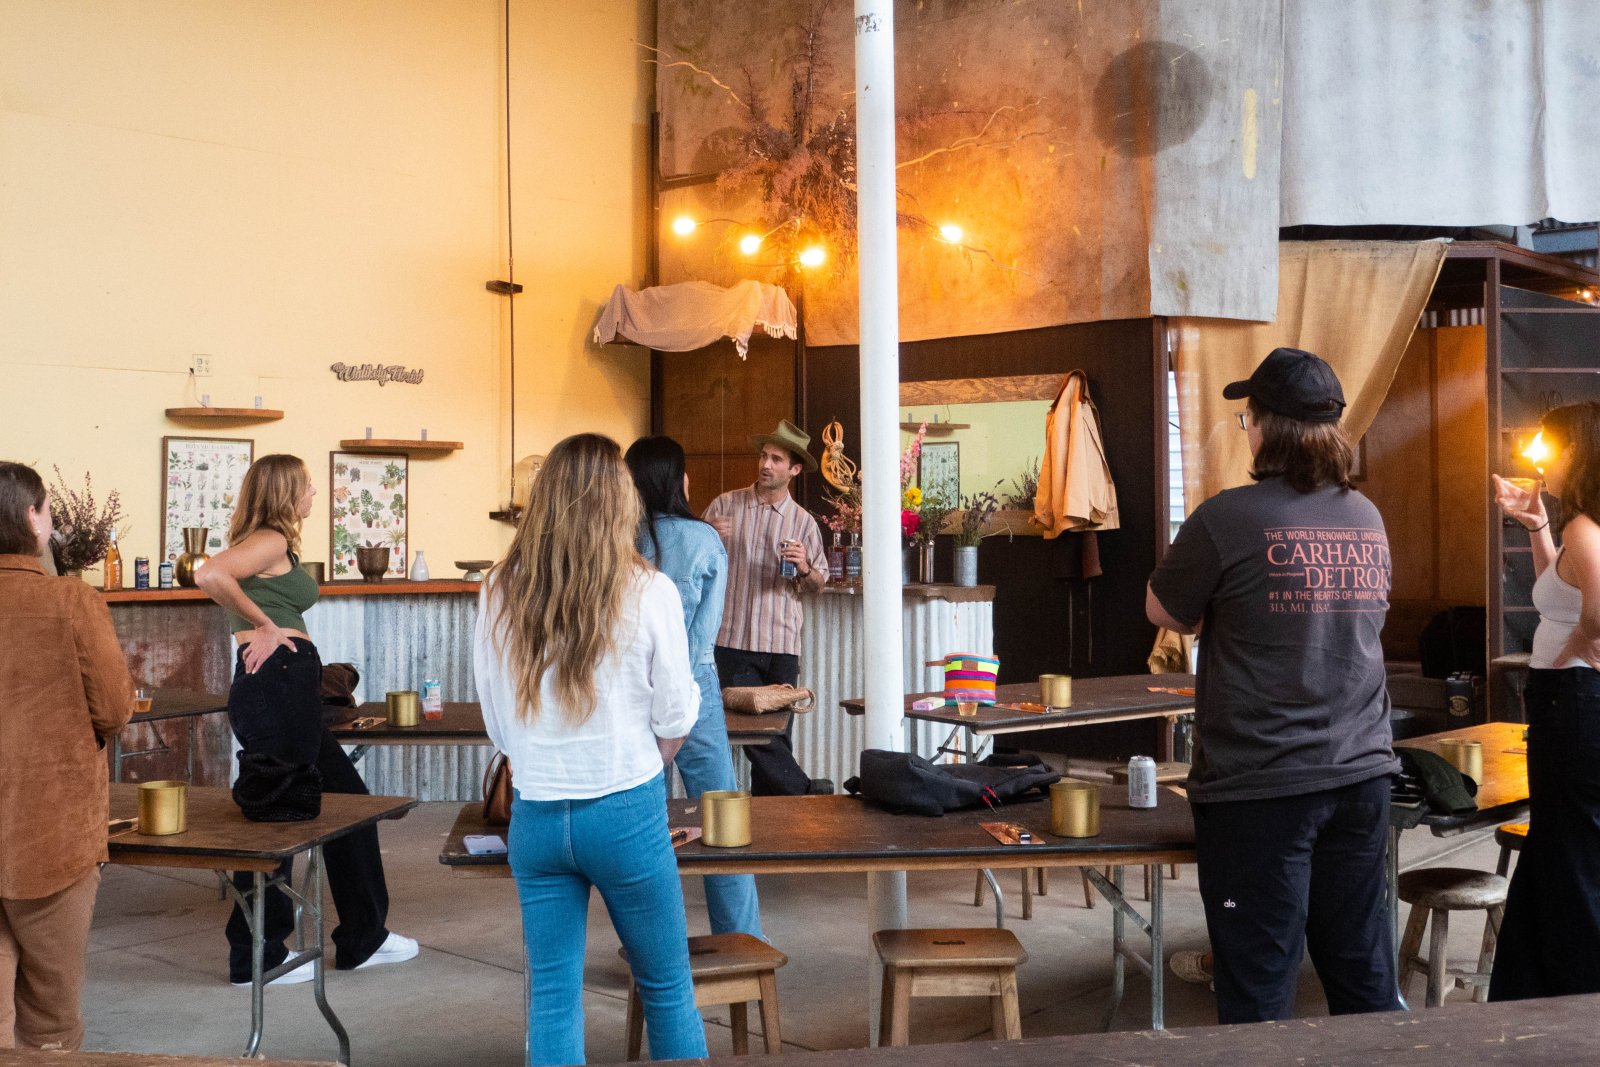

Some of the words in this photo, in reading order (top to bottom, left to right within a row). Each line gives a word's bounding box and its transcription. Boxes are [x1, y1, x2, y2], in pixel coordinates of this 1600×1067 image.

[1264, 531, 1283, 541] THE
[1286, 531, 1315, 541] WORLD
[1317, 531, 1360, 542] RENOWNED,
[1305, 567, 1388, 589] DETROI
[1269, 591, 1279, 600] #1
[1283, 591, 1292, 600] IN
[1295, 591, 1312, 600] THE
[1314, 590, 1340, 600] HEARTS
[1342, 590, 1353, 600] OF
[1224, 898, 1236, 908] alo
